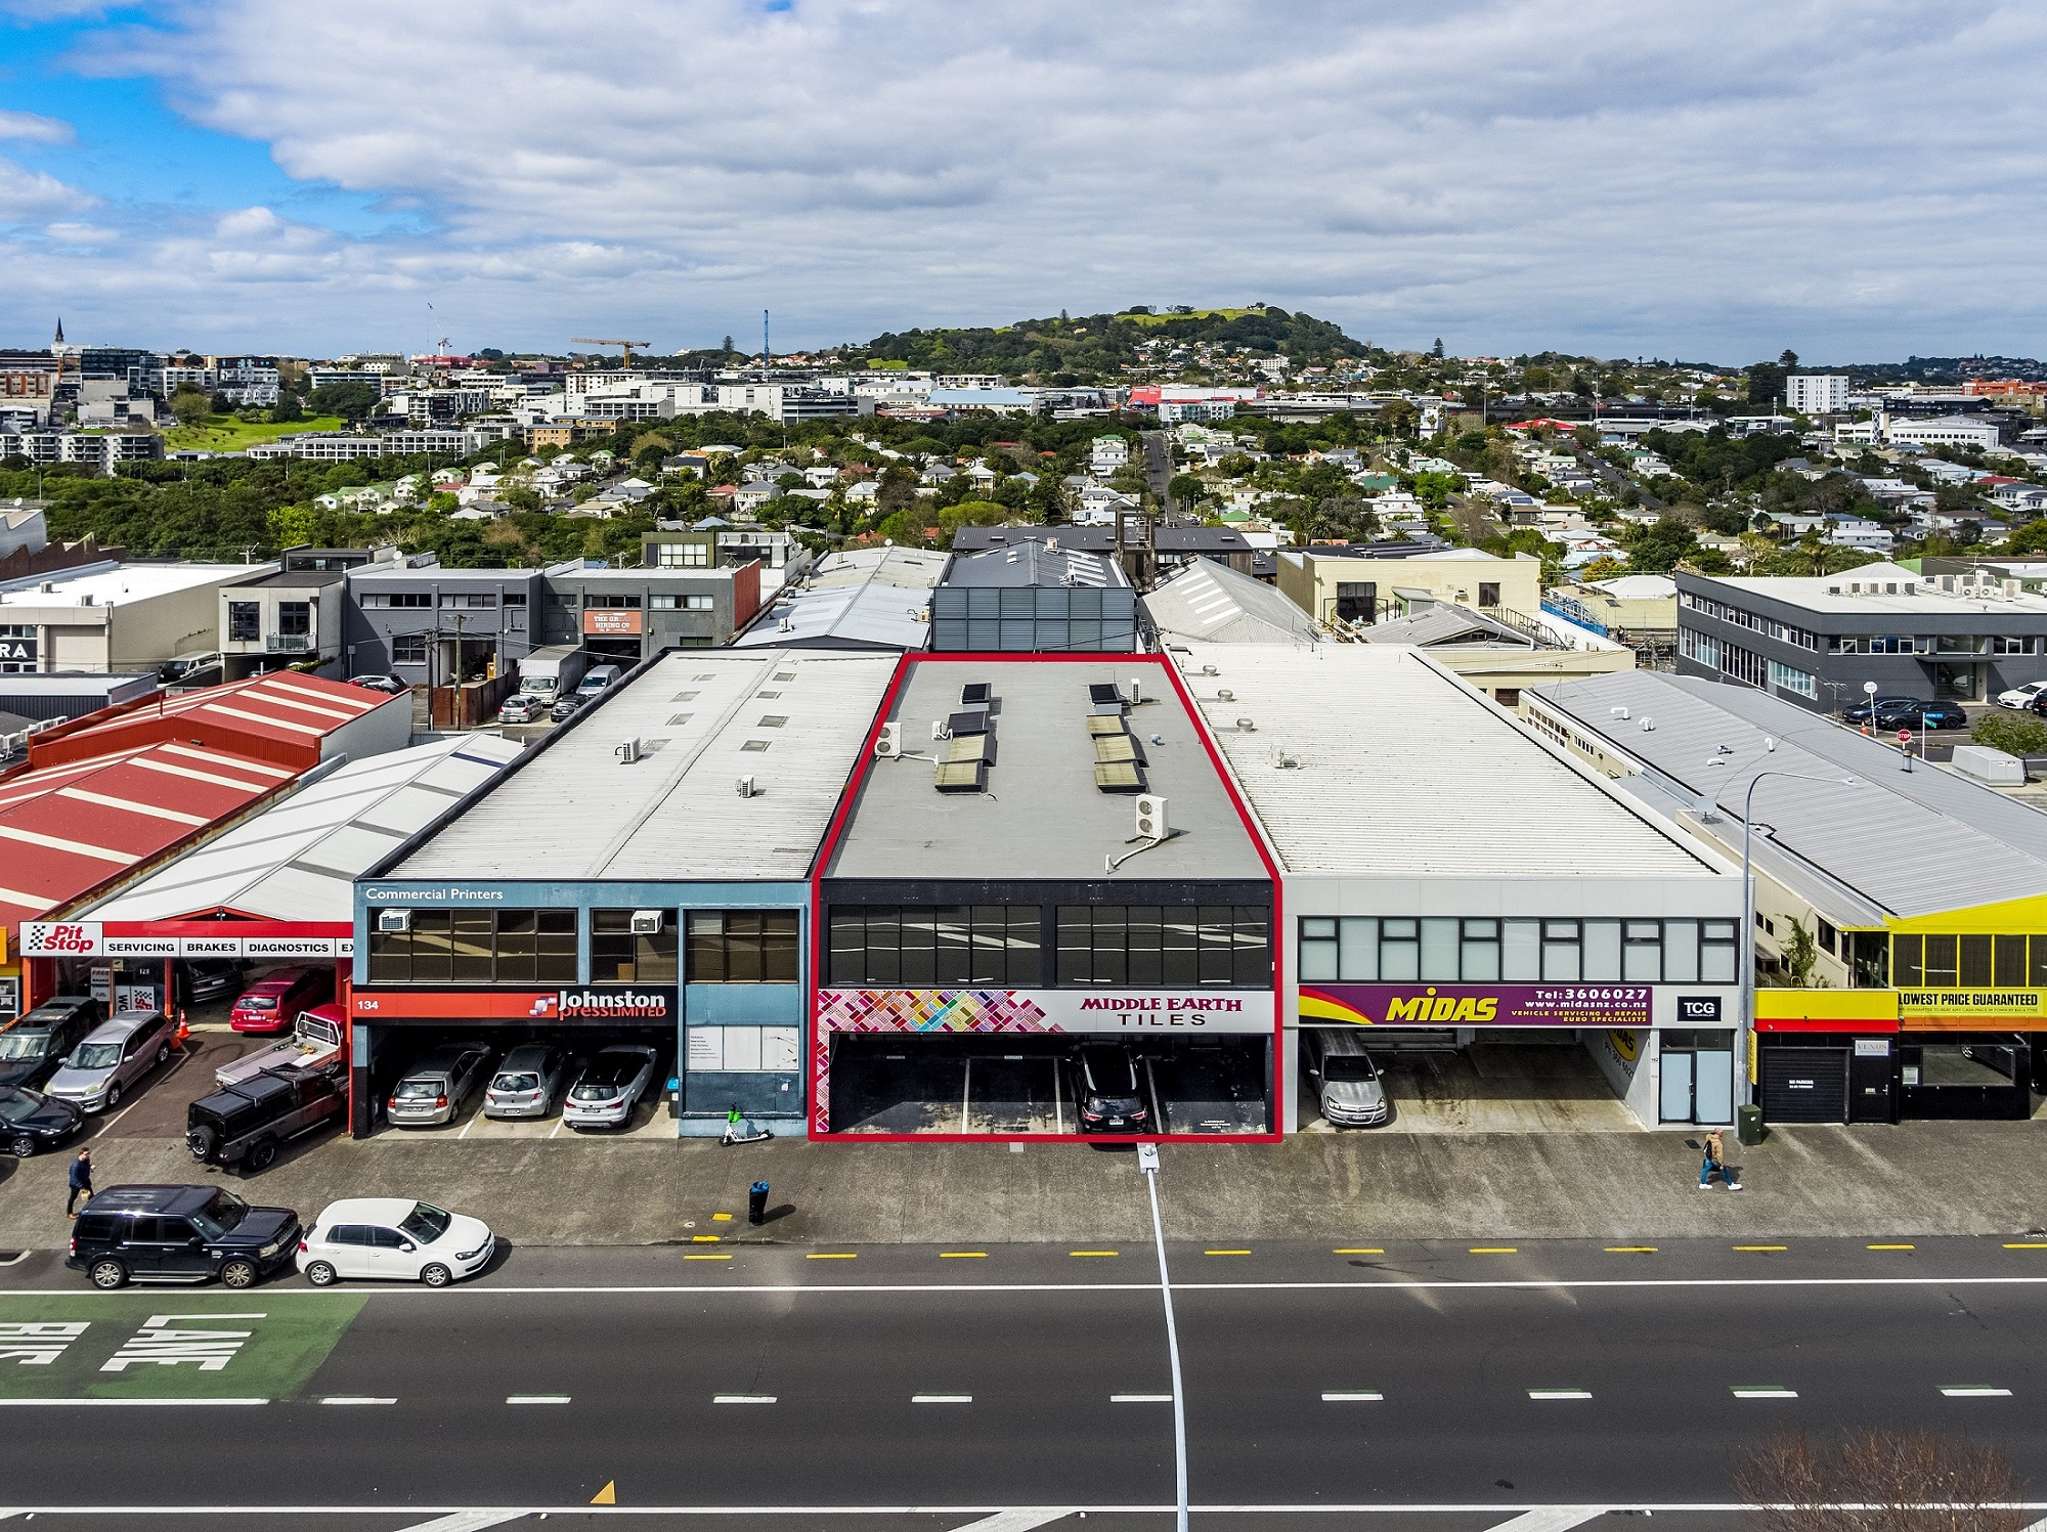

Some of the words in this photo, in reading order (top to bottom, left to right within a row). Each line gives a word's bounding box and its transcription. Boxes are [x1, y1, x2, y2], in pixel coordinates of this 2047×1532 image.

[366, 888, 446, 899] Commercial
[451, 888, 504, 899] Printers
[54, 925, 84, 939] Pit
[43, 936, 94, 953] Stop
[108, 943, 175, 952] SERVICING
[187, 943, 237, 952] BRAKES
[249, 943, 329, 952] DIAGNOSTICS
[358, 1000, 379, 1010] 134
[558, 990, 665, 1011] Johnston
[1080, 998, 1162, 1010] MIDDLE
[1167, 998, 1243, 1011] EARTH
[1899, 993, 1939, 1005] LOWEST
[1941, 993, 1970, 1005] PRICE
[1972, 993, 2038, 1006] GUARANTEED
[1684, 1002, 1715, 1014] TCG
[1117, 1014, 1206, 1026] TILES
[99, 1313, 268, 1371] LANE
